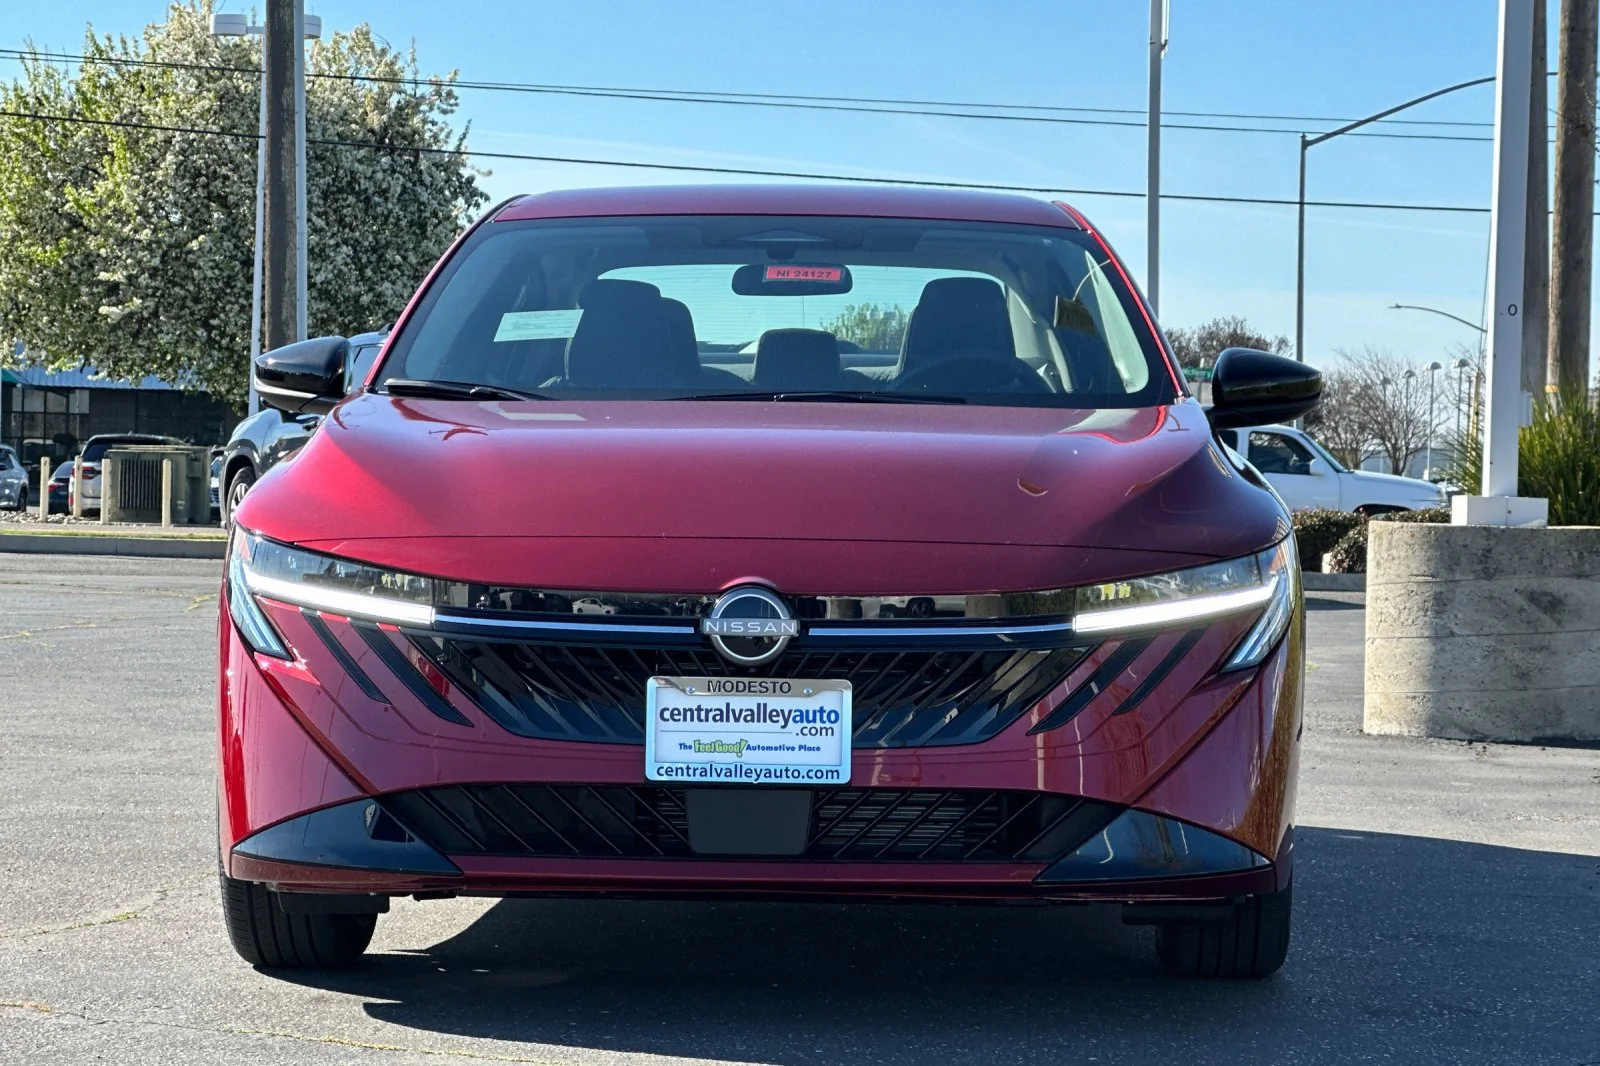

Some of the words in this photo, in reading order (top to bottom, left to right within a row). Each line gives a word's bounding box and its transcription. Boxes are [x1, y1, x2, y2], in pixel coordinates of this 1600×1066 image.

[794, 270, 832, 278] 24127
[705, 621, 795, 633] NISSAN
[707, 680, 792, 695] MODESTO
[659, 702, 840, 729] centralvalleyauto
[795, 725, 835, 737] .com
[746, 743, 796, 753] Automotive
[798, 744, 821, 752] Place
[656, 764, 840, 782] centralvalleyauto.com
